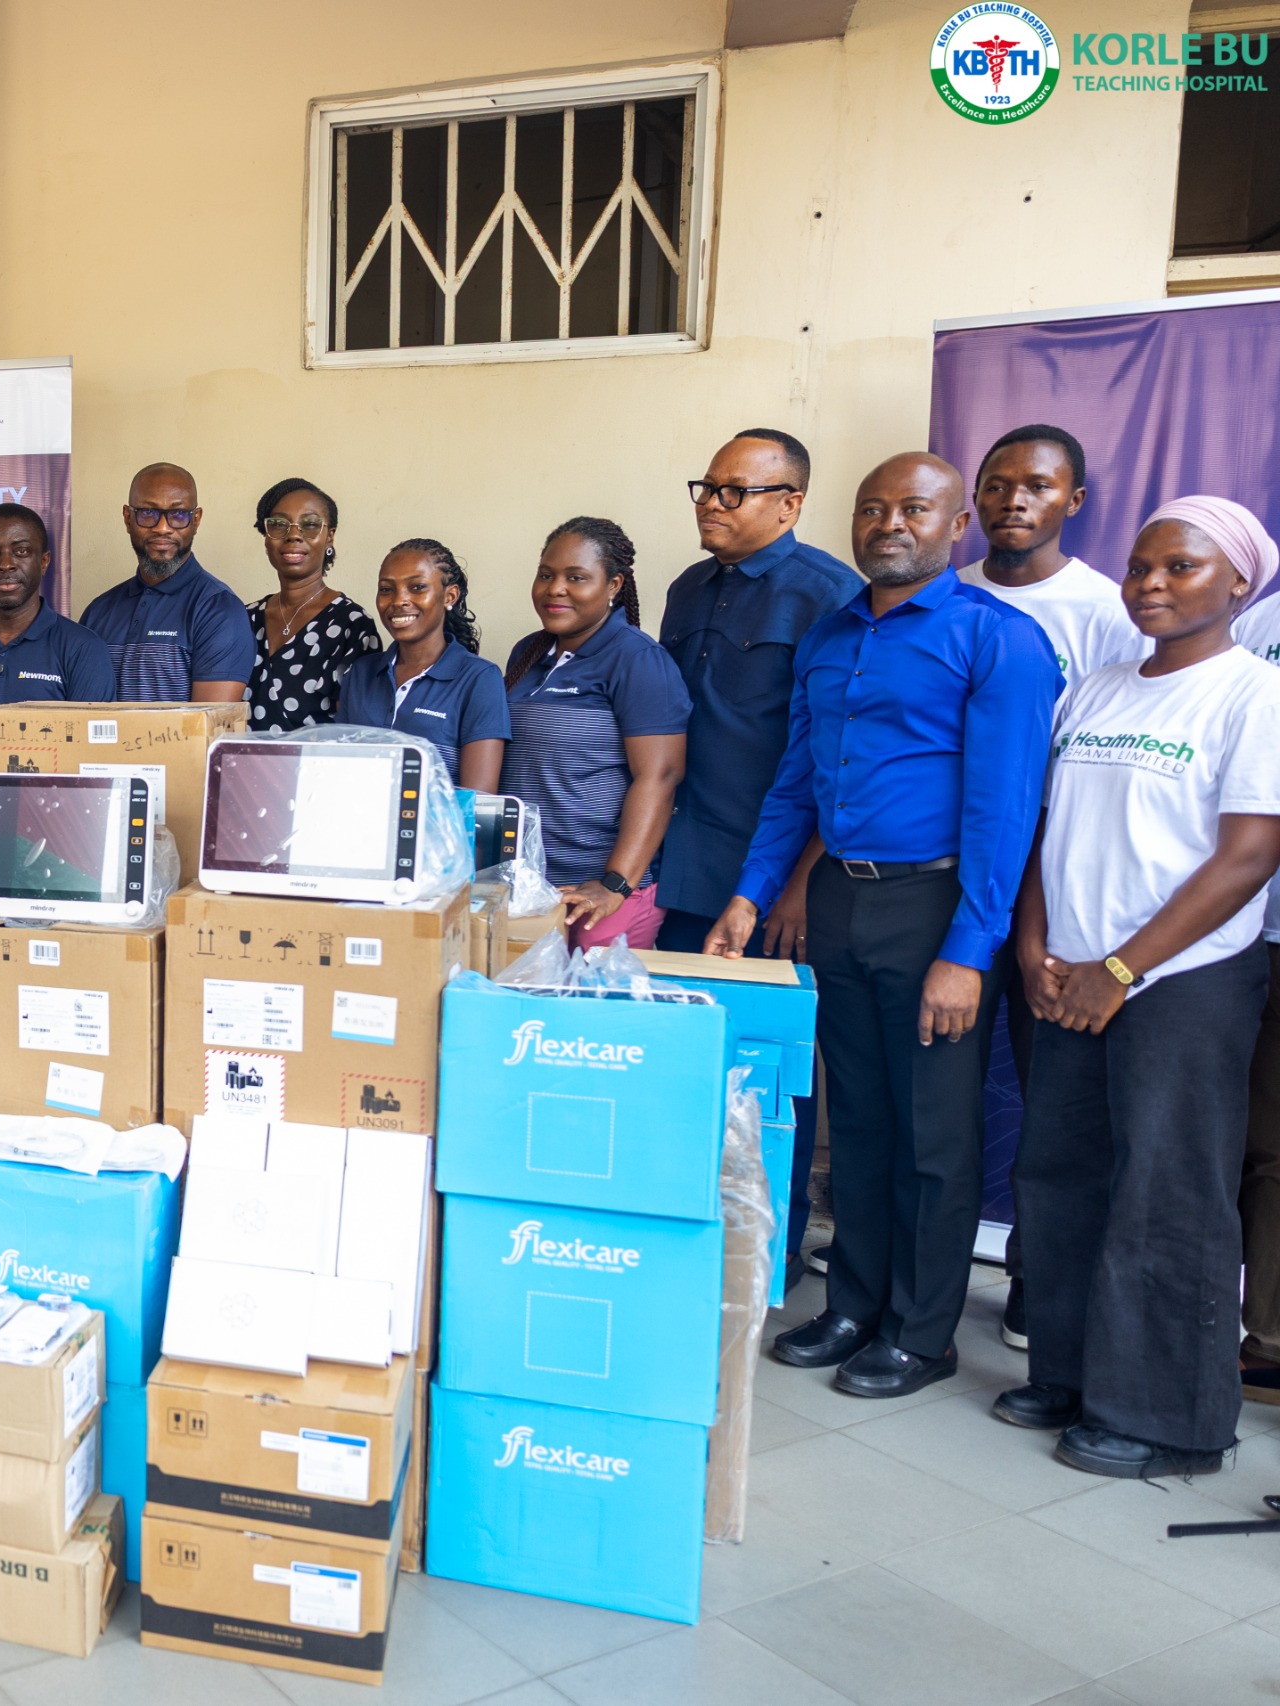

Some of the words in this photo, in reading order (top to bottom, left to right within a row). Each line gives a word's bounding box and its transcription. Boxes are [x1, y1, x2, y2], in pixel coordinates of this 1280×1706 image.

[414, 707, 447, 719] Newmont
[1071, 731, 1195, 763] HealthTech
[1063, 747, 1112, 759] GHANA
[1117, 751, 1186, 774] LIMITED
[290, 881, 318, 889] mindray
[503, 1019, 645, 1066] flexicare
[221, 1092, 267, 1104] UN3481
[356, 1115, 404, 1130] UN3091
[501, 1220, 641, 1267] flexicare
[494, 1425, 630, 1476] flexicare
[34, 1566, 49, 1583] B
